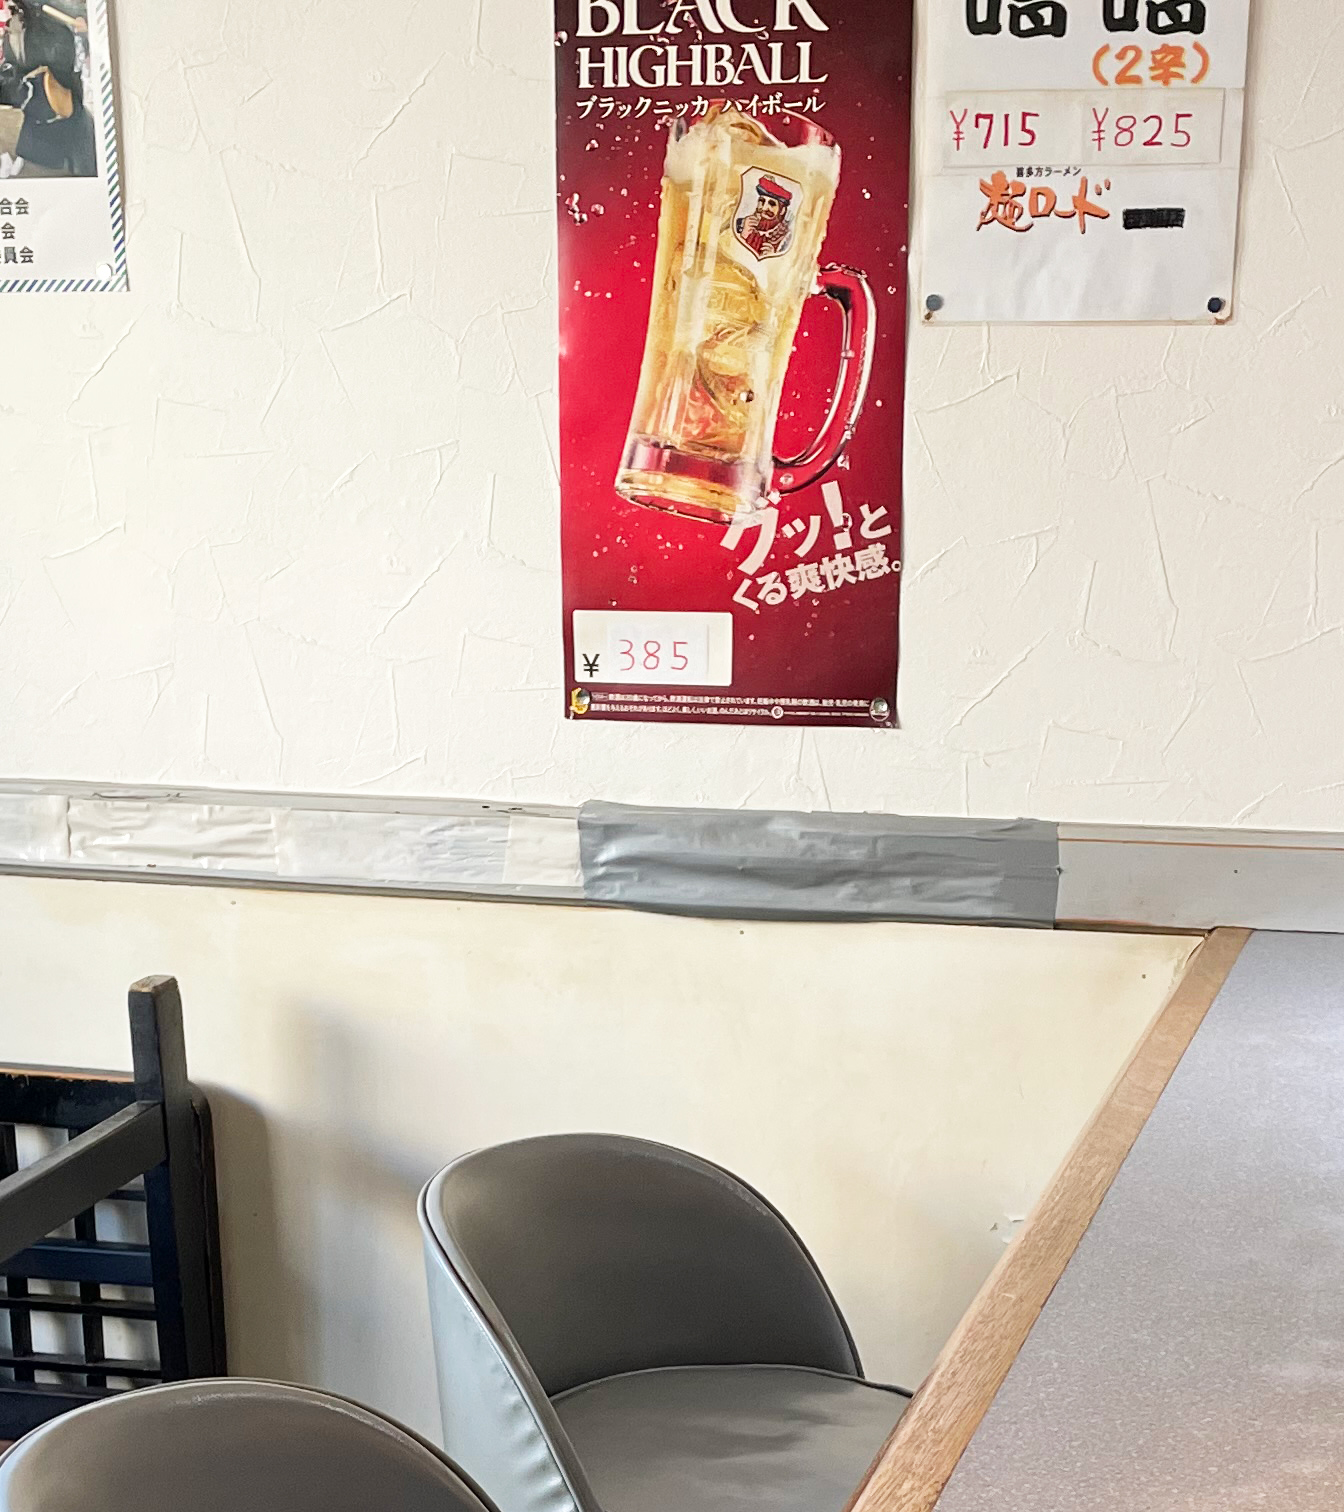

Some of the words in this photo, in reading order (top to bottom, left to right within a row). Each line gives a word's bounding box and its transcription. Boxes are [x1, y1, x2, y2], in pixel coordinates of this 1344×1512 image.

[576, 41, 828, 88] HIGHBALL
[576, 96, 710, 119] ブラックニッカ
[721, 93, 826, 117] ハイボール
[949, 108, 1040, 151] ¥715
[1092, 107, 1193, 151] ¥825
[1015, 166, 1082, 178] 喜多方ラーメン
[732, 542, 902, 611] くる爽快感。
